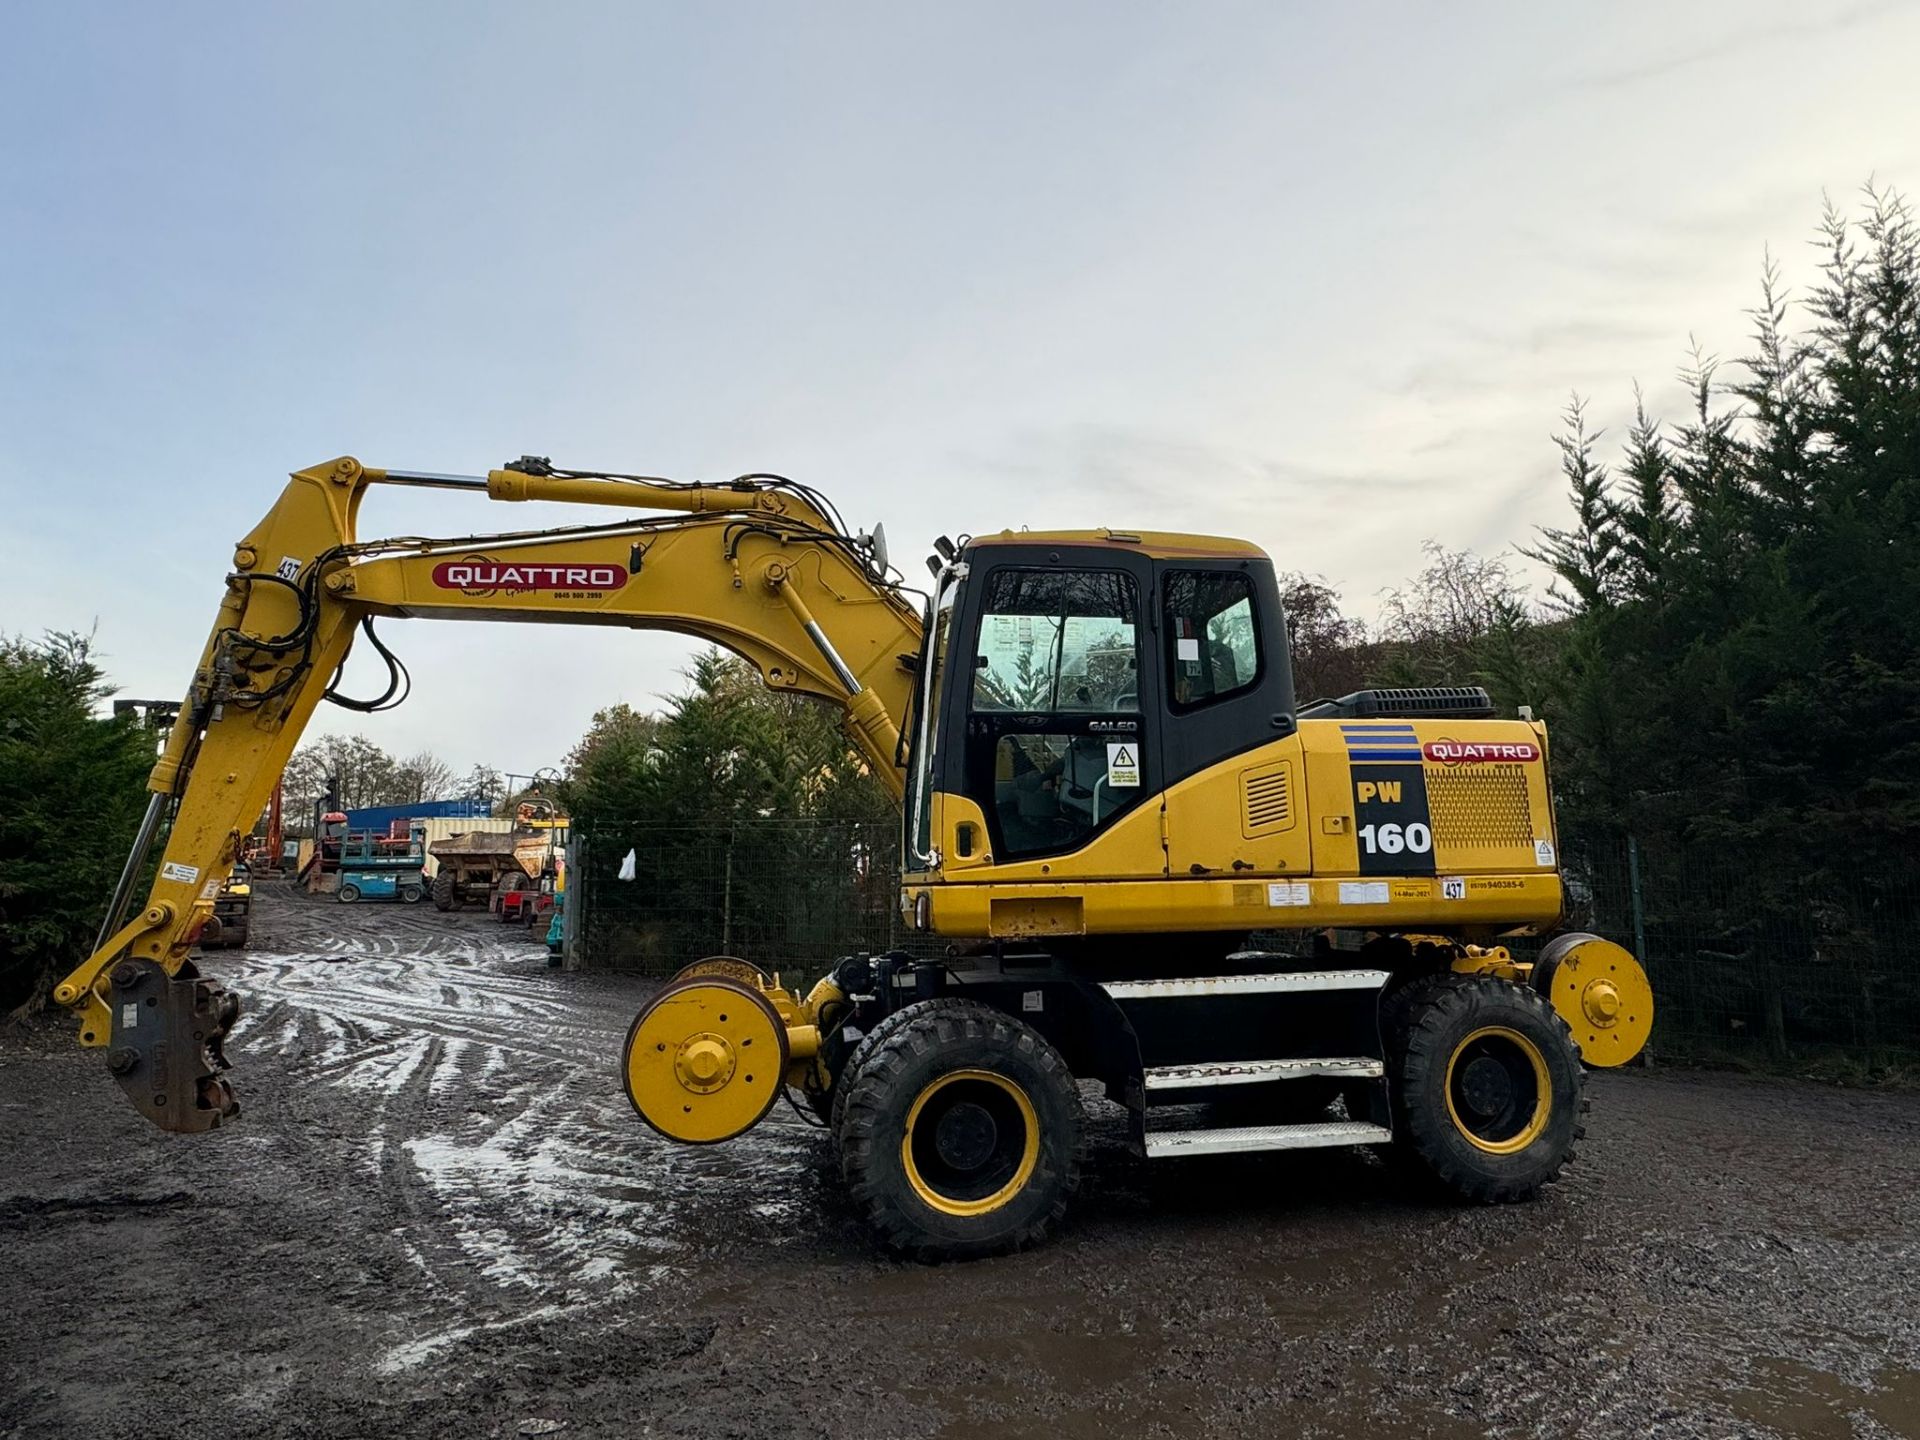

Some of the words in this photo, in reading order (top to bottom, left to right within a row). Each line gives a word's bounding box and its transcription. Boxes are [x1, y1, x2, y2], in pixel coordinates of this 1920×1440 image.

[277, 560, 299, 579] 437
[447, 566, 613, 587] QUATTRO
[1088, 721, 1138, 731] GALEO
[1431, 744, 1533, 760] QUATTRO
[1356, 781, 1402, 803] PW
[1358, 822, 1432, 854] 160
[1446, 883, 1462, 899] 437
